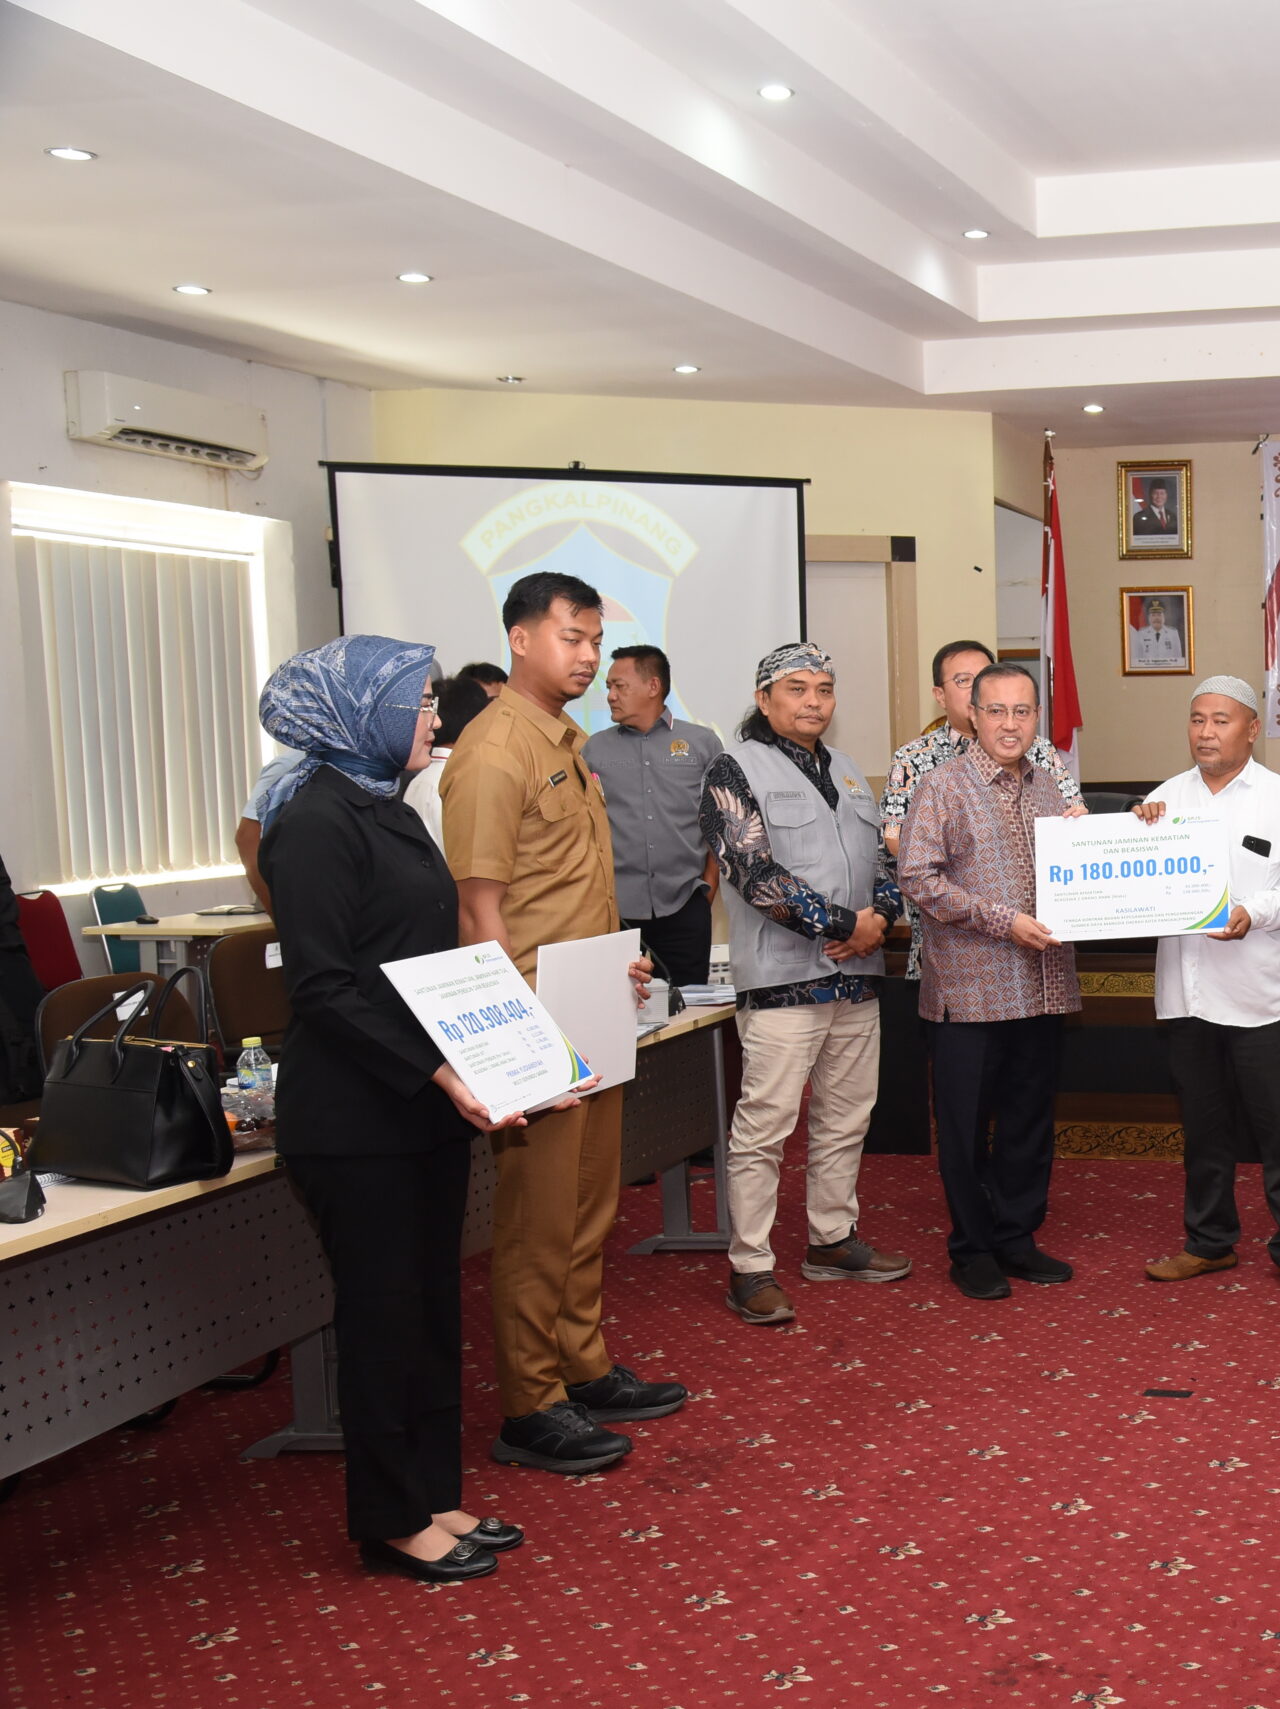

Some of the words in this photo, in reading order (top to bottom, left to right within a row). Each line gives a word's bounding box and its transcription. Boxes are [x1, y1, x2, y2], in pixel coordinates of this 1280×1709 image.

[480, 490, 682, 556] PANGKALPINANG
[1071, 839, 1113, 847] SANTUNAN
[1114, 837, 1149, 845] JAMINAN
[1151, 834, 1190, 842] KEMATIAN
[1103, 847, 1119, 855] DAN
[1121, 845, 1159, 853] BEASISWA
[1049, 865, 1074, 886] Rp
[1080, 856, 1214, 881] 180.000.000,-
[1115, 905, 1156, 914] KASILAWATI
[437, 1020, 465, 1043] Rp
[457, 998, 534, 1035] 120.908.404,-
